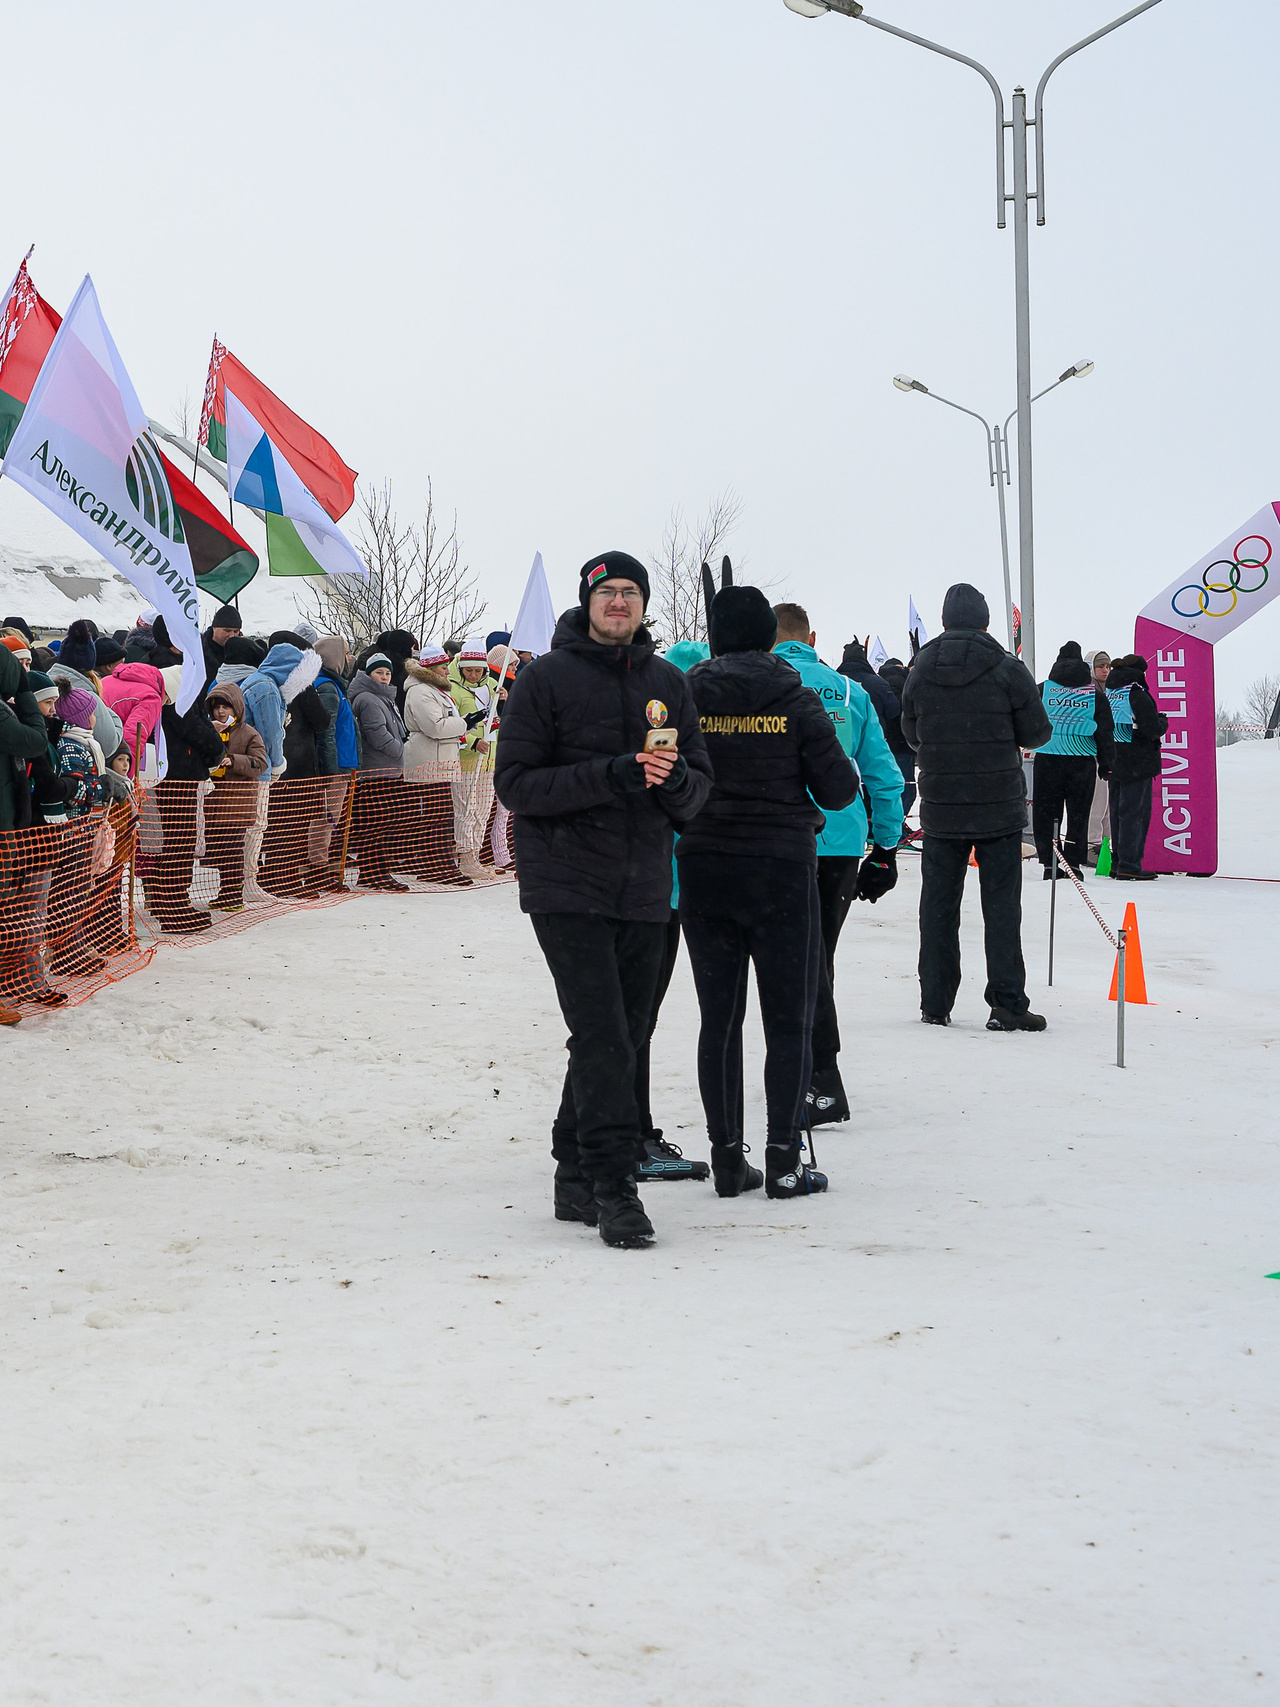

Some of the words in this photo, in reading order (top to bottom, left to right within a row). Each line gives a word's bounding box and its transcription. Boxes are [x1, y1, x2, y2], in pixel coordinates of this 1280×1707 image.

[29, 439, 199, 629] Александрийс
[1048, 697, 1090, 710] СУДЬЯ
[1156, 648, 1188, 718] LIFE
[699, 714, 788, 736] САНДРИЙСКОЕ
[1159, 730, 1193, 856] ACTIVE
